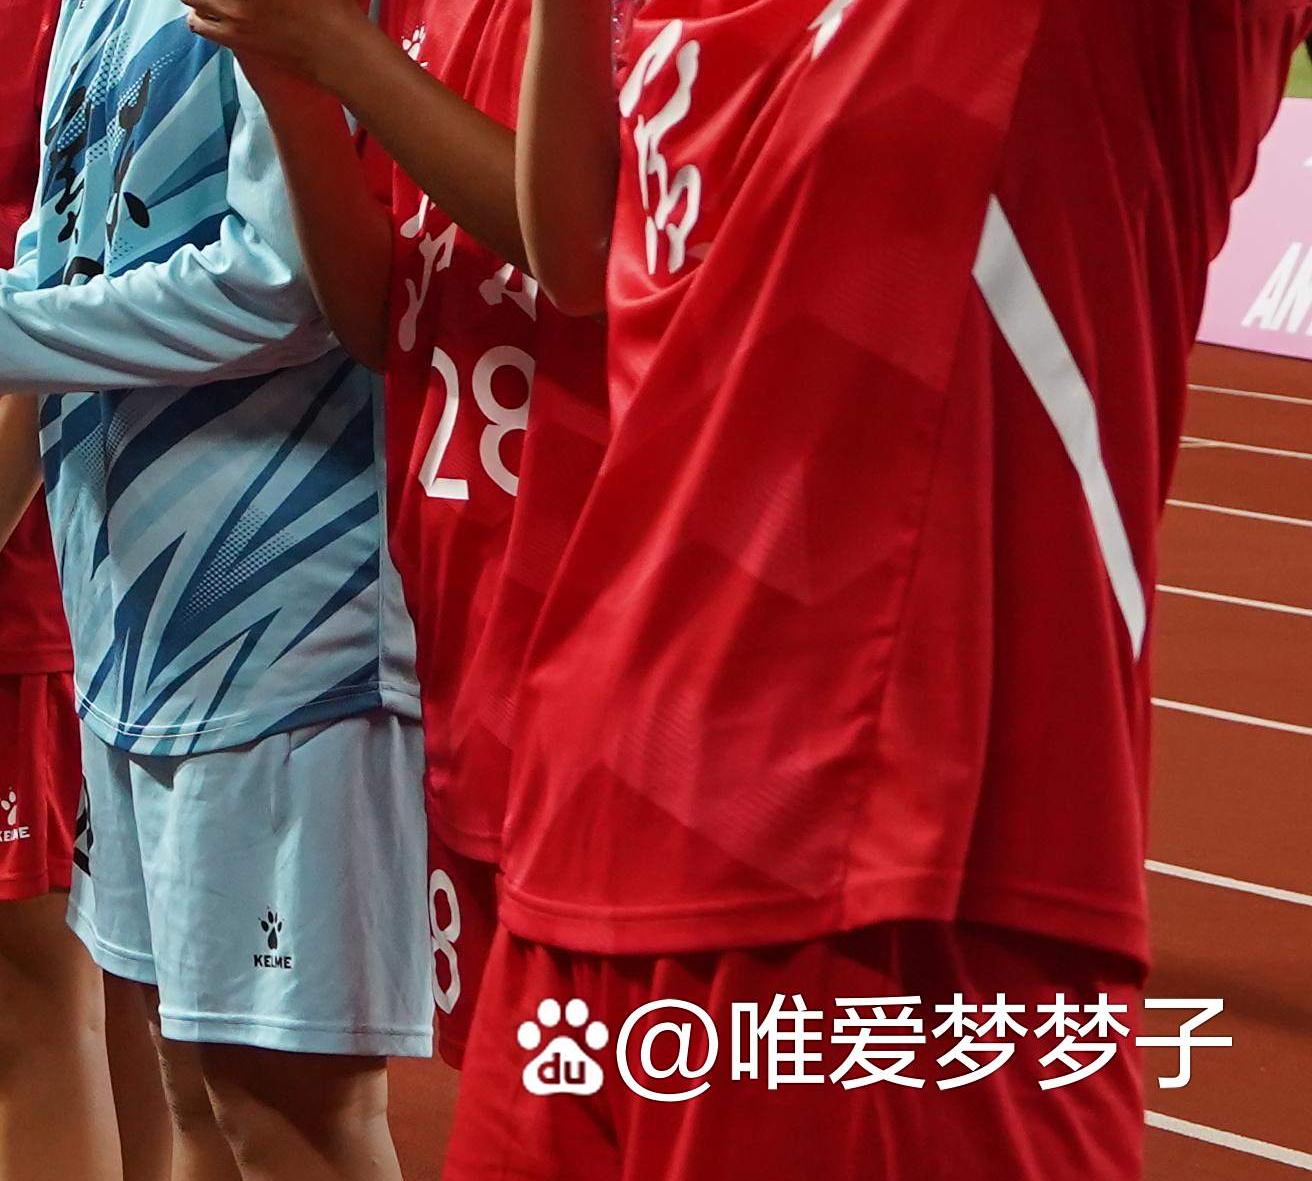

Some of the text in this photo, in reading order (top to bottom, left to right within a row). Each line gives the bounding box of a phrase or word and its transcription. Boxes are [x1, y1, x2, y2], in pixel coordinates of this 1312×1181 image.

[419, 344, 536, 501] 28
[253, 954, 292, 969] KELME
[429, 869, 460, 1014] 8
